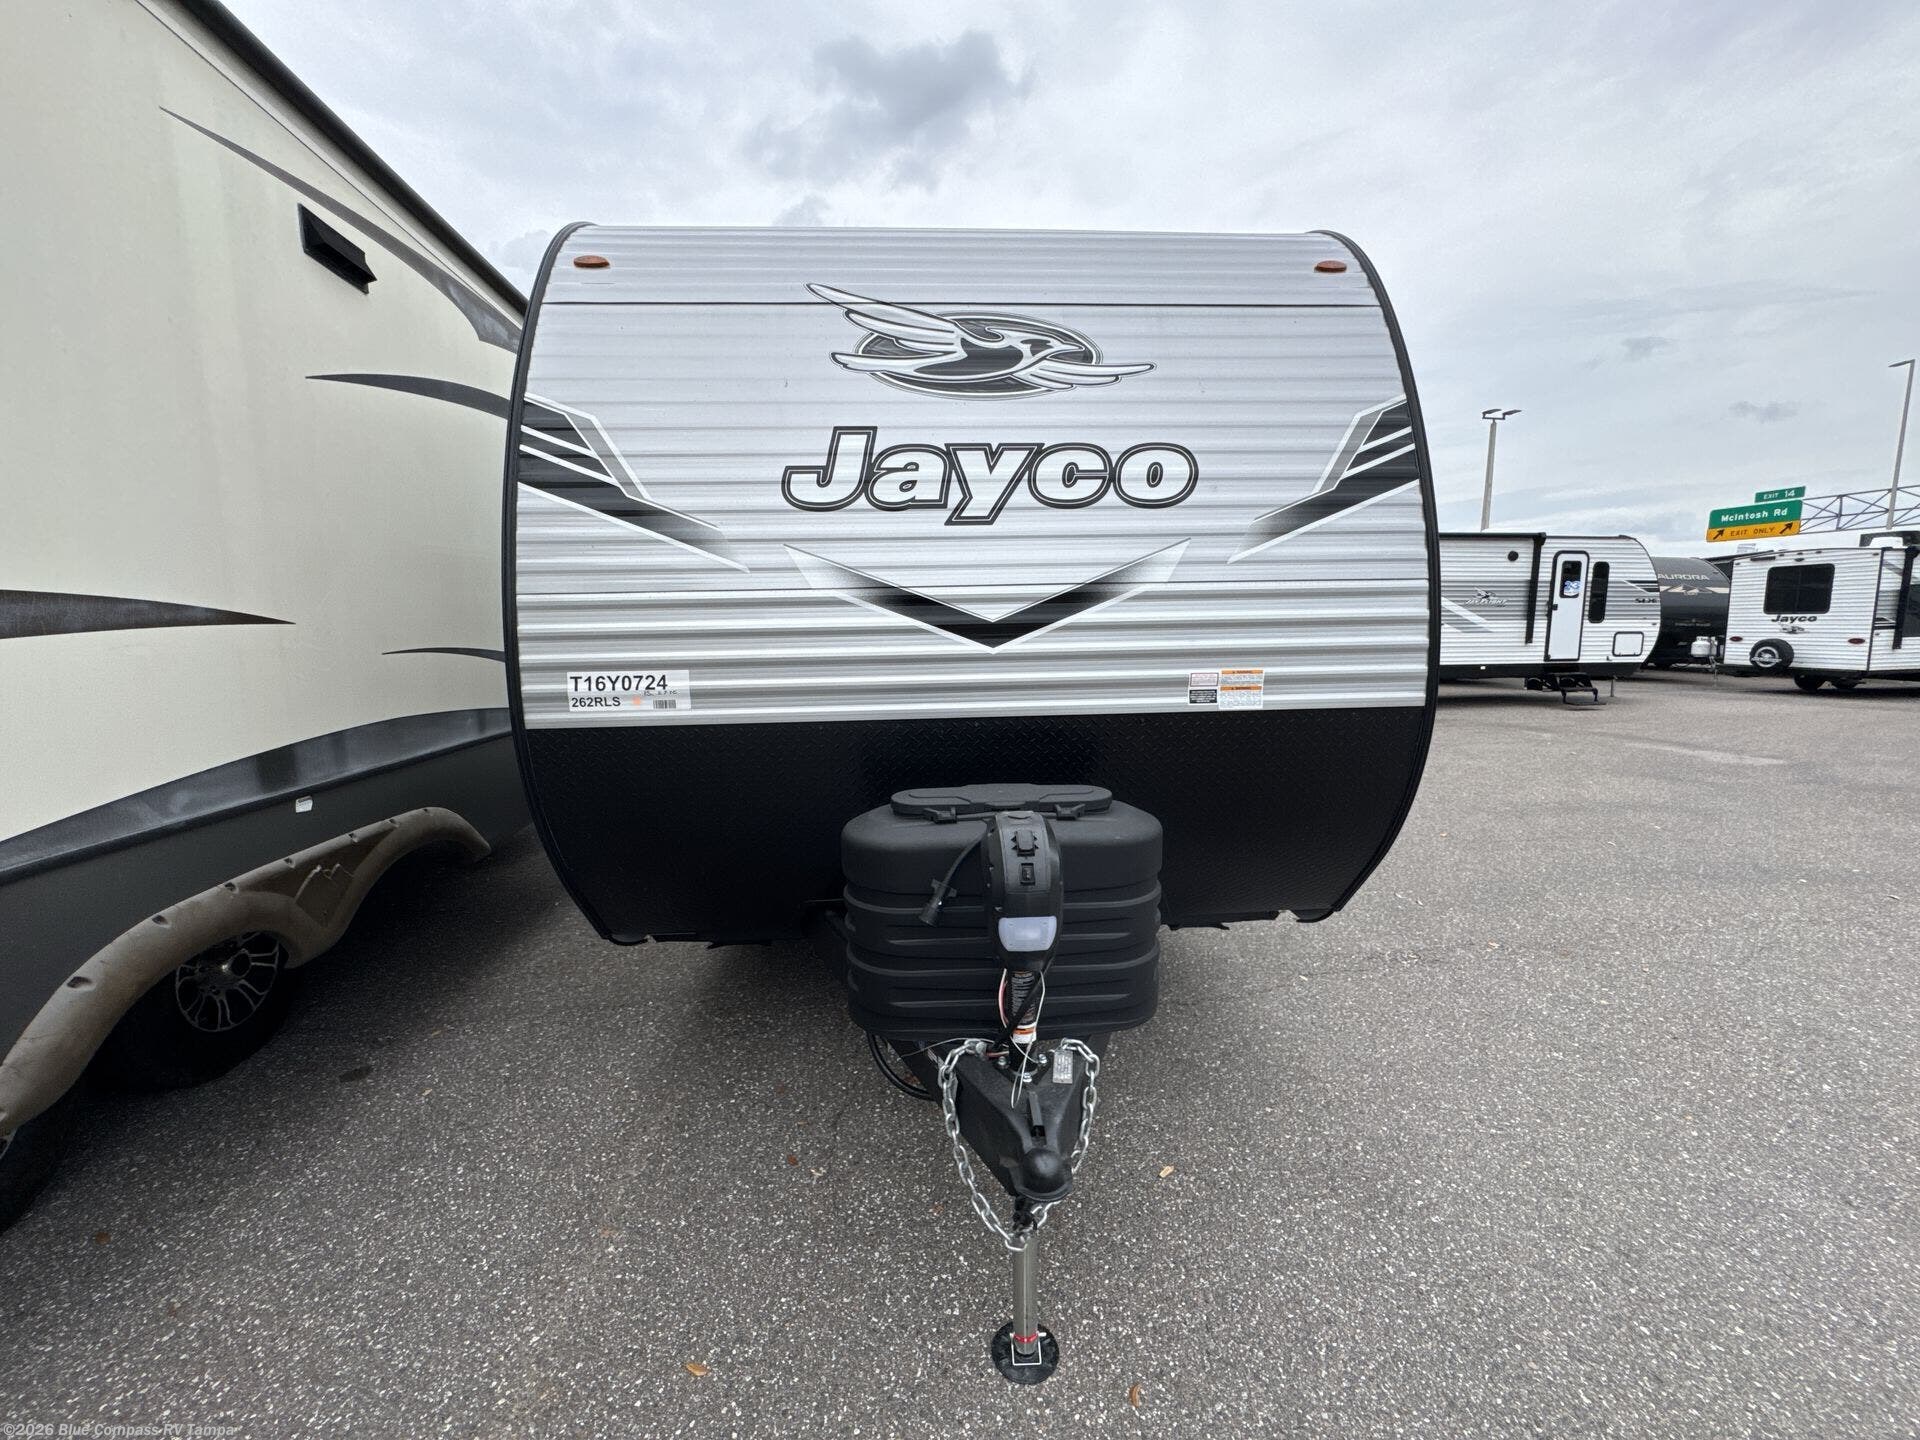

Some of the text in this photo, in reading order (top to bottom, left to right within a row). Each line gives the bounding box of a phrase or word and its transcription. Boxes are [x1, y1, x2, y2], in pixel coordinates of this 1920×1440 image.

[781, 426, 1199, 526] Jayco
[1763, 490, 1796, 500] EXIT 14
[1721, 508, 1788, 522] McIntosh Rd
[1730, 526, 1776, 537] EXIT ONLY
[1657, 573, 1710, 581] AURORA
[1771, 614, 1818, 624] Jayco
[570, 674, 668, 692] T16Y0724
[571, 696, 621, 708] 262RLS
